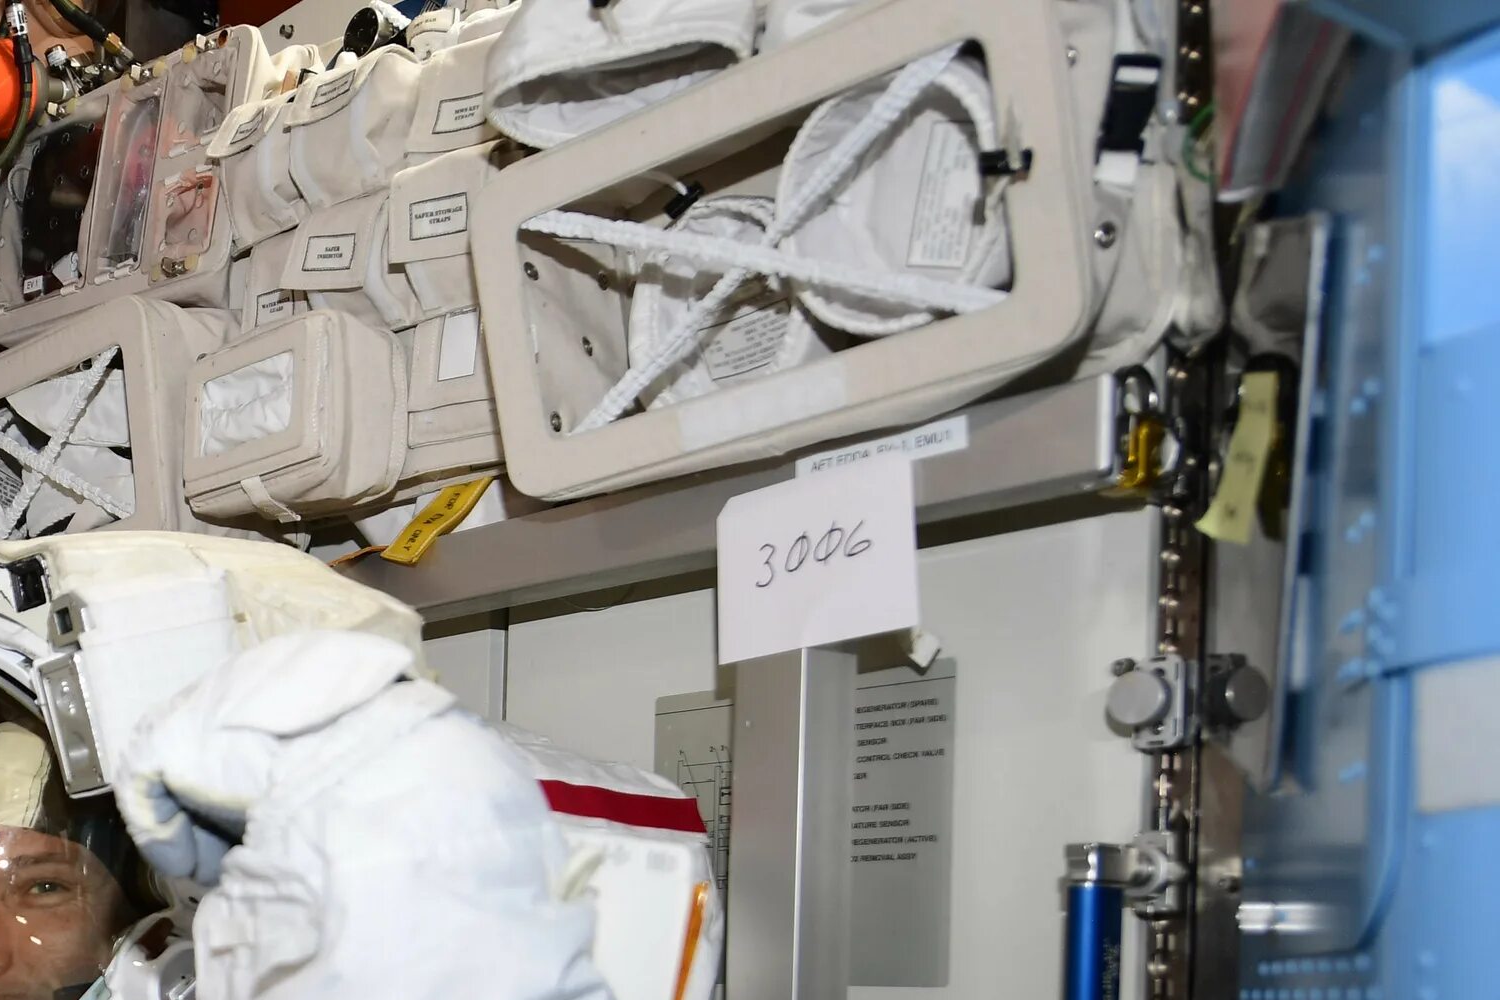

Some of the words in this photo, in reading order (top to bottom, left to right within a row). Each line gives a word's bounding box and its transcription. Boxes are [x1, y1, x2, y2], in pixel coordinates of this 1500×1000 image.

[414, 210, 433, 220] SAFER
[434, 206, 463, 217] STOWAGE
[429, 216, 452, 224] STRAPS
[811, 459, 832, 472] AFT
[444, 492, 460, 510] FOR
[423, 513, 445, 524] EVA
[404, 529, 422, 552] ONLY
[756, 520, 871, 587] 3006
[857, 738, 887, 747] SENSOR
[856, 754, 891, 763] CONTROL
[893, 751, 919, 760] CHECK
[921, 749, 945, 757] VALVE
[878, 820, 909, 828] SENSOR
[860, 854, 894, 862] REMOVAL
[896, 852, 917, 860] ASSY
